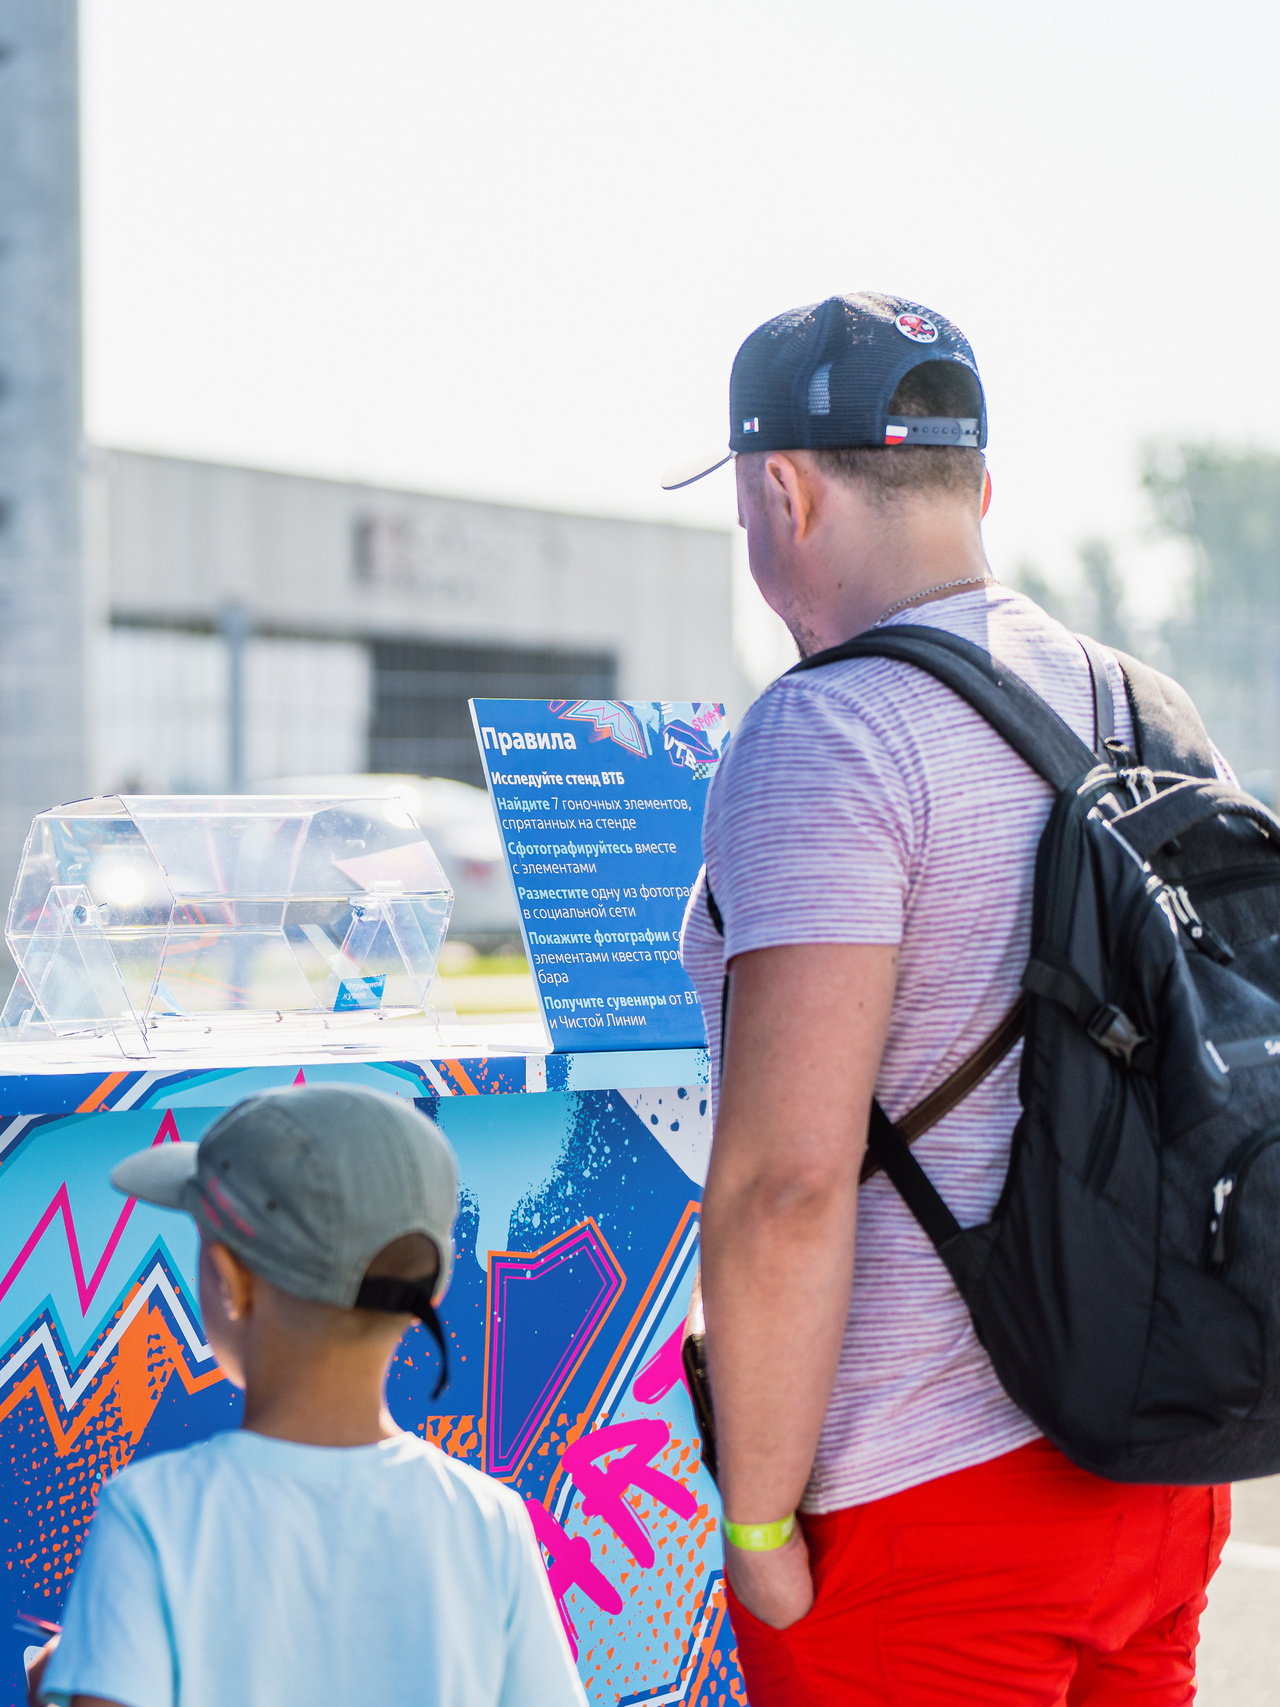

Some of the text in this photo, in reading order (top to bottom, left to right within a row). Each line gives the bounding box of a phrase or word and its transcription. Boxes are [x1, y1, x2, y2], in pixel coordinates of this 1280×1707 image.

[691, 707, 722, 731] SPORT
[481, 726, 577, 756] Правила
[664, 732, 696, 771] VTB
[491, 771, 625, 788] Исследуйте стенд ВТБ
[497, 796, 692, 813] Найдите 7 гоночных элементов,
[502, 817, 637, 833] спрятанных на стенде
[508, 840, 677, 859] Сфотографируйтесь вместе
[513, 862, 597, 875] с элементами
[518, 886, 589, 900] Разместите
[591, 887, 620, 902] одну
[623, 887, 638, 898] из
[523, 903, 637, 921] в социальной сети
[528, 930, 592, 945] Покажите
[593, 928, 671, 947] фотографии
[533, 952, 610, 965] элементами
[611, 950, 652, 963] квеста
[538, 968, 569, 987] бара
[543, 990, 699, 1013] Получите сувениры от ВТ
[549, 1012, 647, 1030] и Чистой Линии
